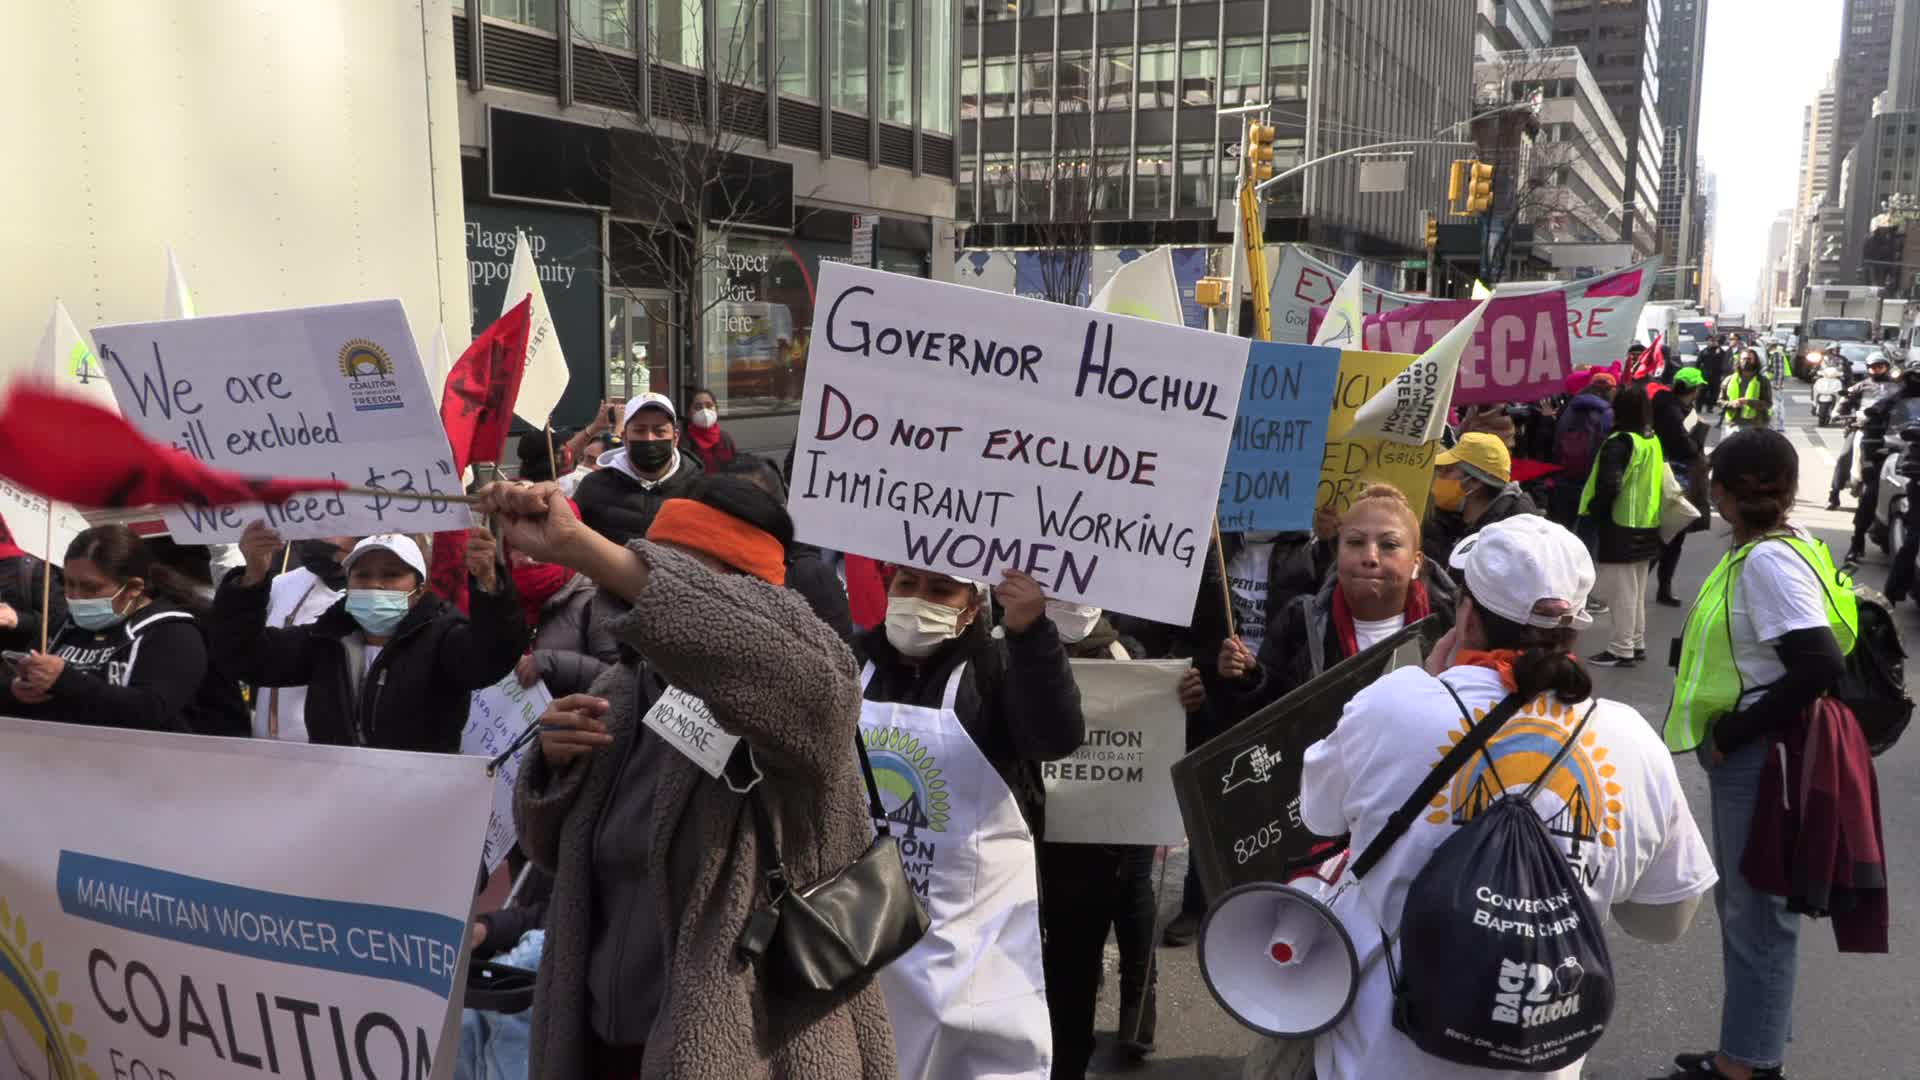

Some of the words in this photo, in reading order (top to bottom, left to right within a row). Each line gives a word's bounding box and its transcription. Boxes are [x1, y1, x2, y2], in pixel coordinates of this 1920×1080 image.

[715, 244, 769, 277] Expect
[714, 277, 756, 302] More
[714, 309, 753, 333] Here
[226, 371, 292, 405] are
[348, 380, 396, 391] COALITION
[353, 395, 401, 404] FREEDOM
[226, 412, 342, 455] excluded
[890, 418, 963, 452] NOT
[981, 428, 1158, 486] EXCLUDE
[177, 502, 243, 534] We
[263, 472, 345, 528] need
[903, 520, 1099, 595] WOMEN
[655, 703, 674, 724] NO
[672, 714, 716, 752] MORE
[1043, 763, 1144, 783] REEDOM
[1234, 820, 1282, 865] 8205
[77, 877, 209, 934] MANHATTAN
[215, 906, 338, 957] WORKER
[346, 927, 457, 980] CENTER
[1492, 957, 1527, 1024] BACK
[1526, 964, 1553, 1002] 2
[1521, 994, 1580, 1029] SCHOOL
